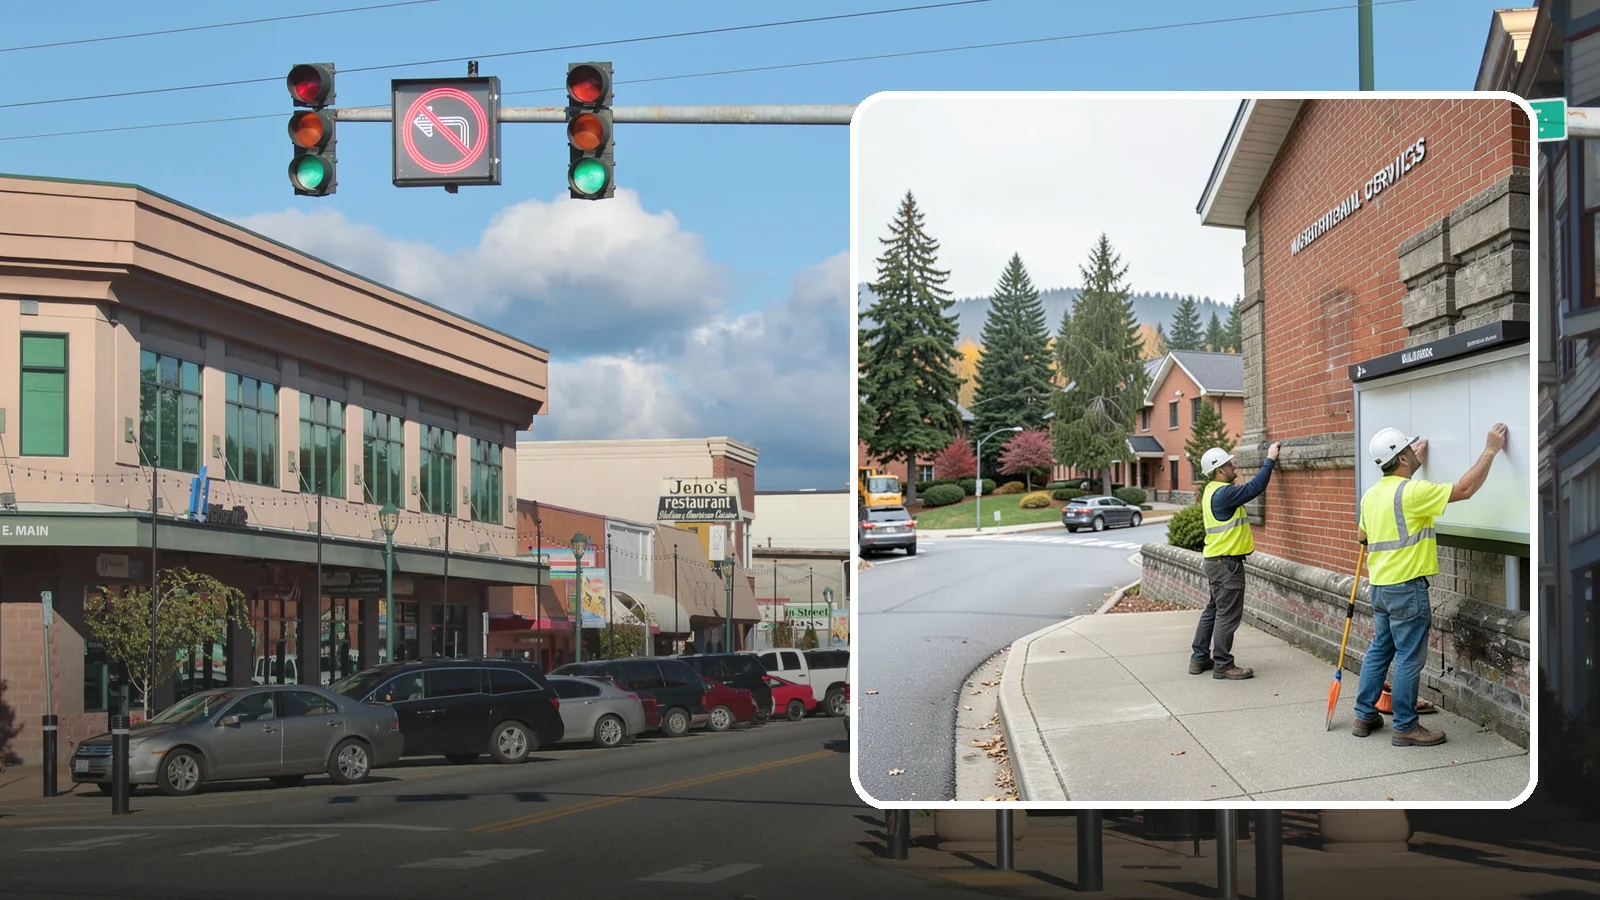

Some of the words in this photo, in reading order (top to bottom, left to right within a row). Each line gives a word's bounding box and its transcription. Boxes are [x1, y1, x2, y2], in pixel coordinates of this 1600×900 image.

[669, 480, 728, 495] Jeno's
[665, 496, 731, 509] restaurant
[658, 510, 681, 520] Italian
[686, 509, 714, 519] American
[715, 509, 738, 519] Cuisine
[2, 525, 13, 536] E.
[15, 525, 49, 536] MAIN
[786, 607, 795, 617] in
[797, 607, 828, 617] Street
[790, 619, 824, 627] lass
